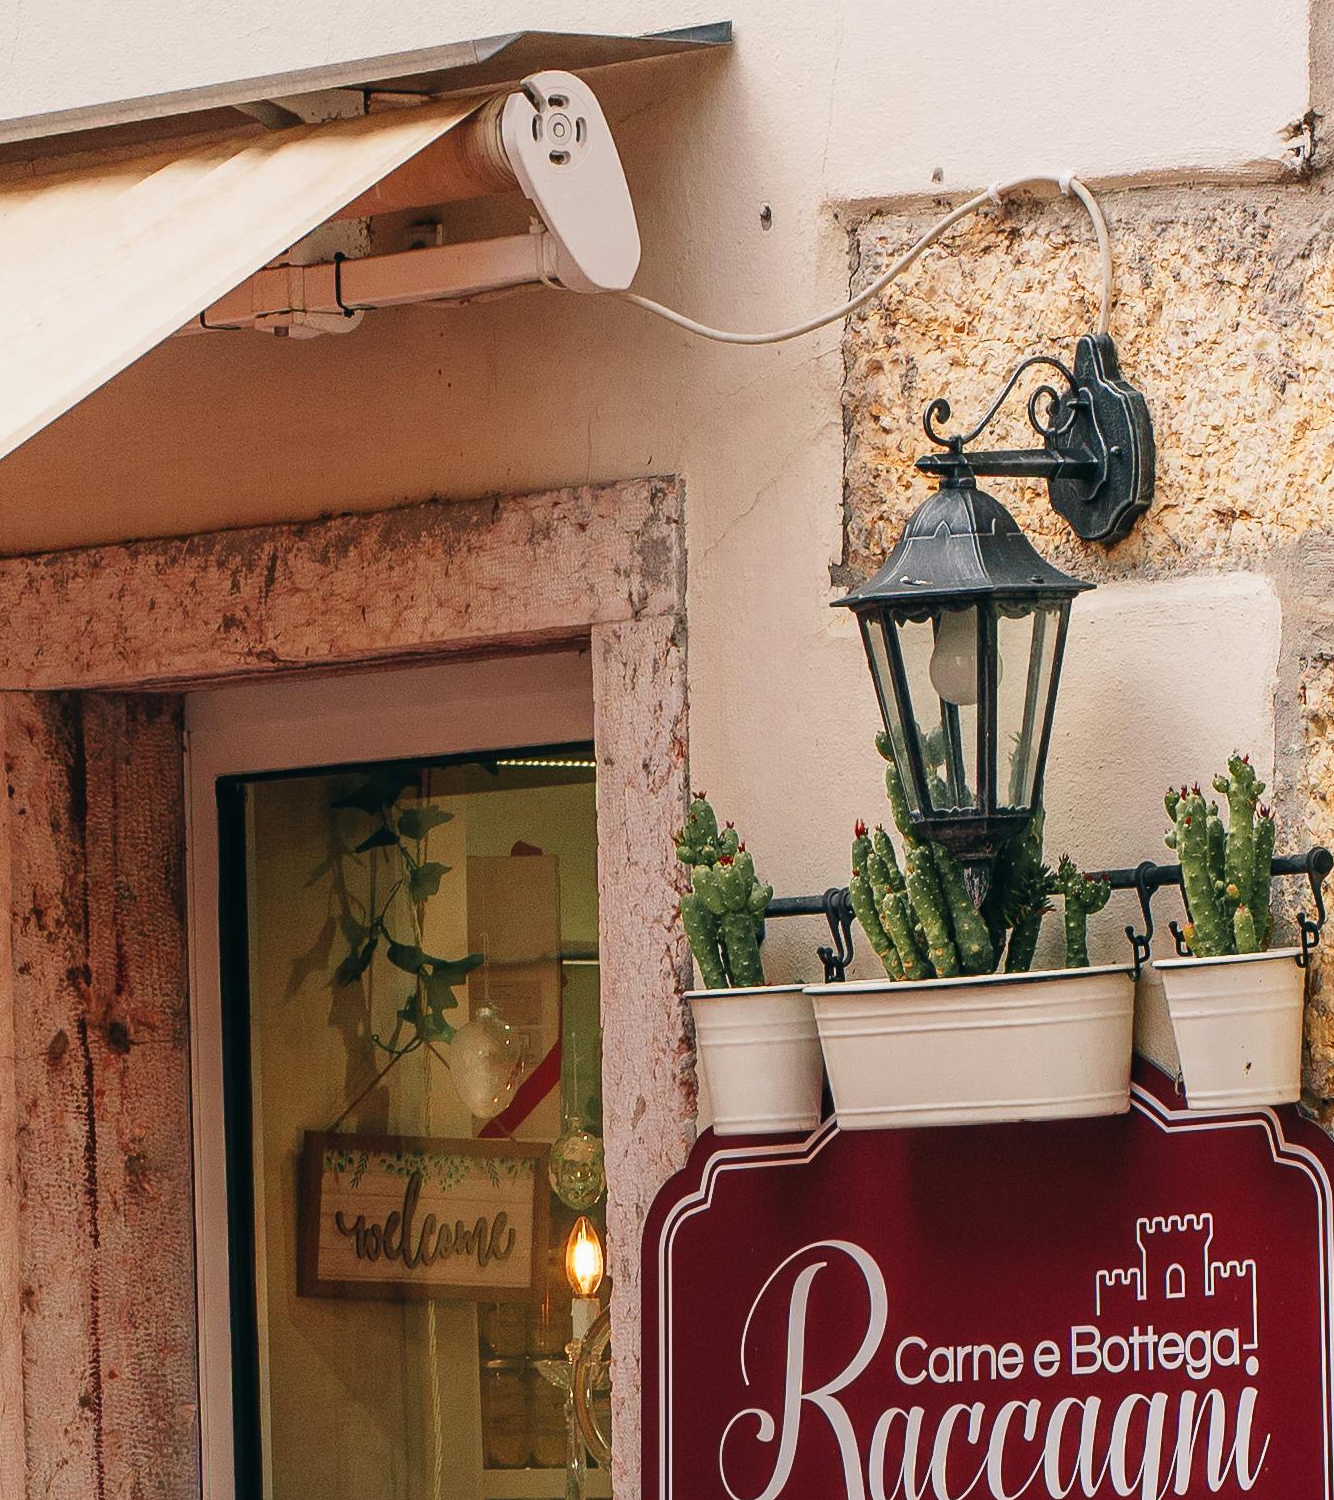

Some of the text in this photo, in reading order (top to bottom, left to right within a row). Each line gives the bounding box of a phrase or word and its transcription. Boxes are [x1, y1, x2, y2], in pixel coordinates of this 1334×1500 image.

[335, 1171, 516, 1270] welcome
[894, 1325, 1242, 1386] Carne e Bottega
